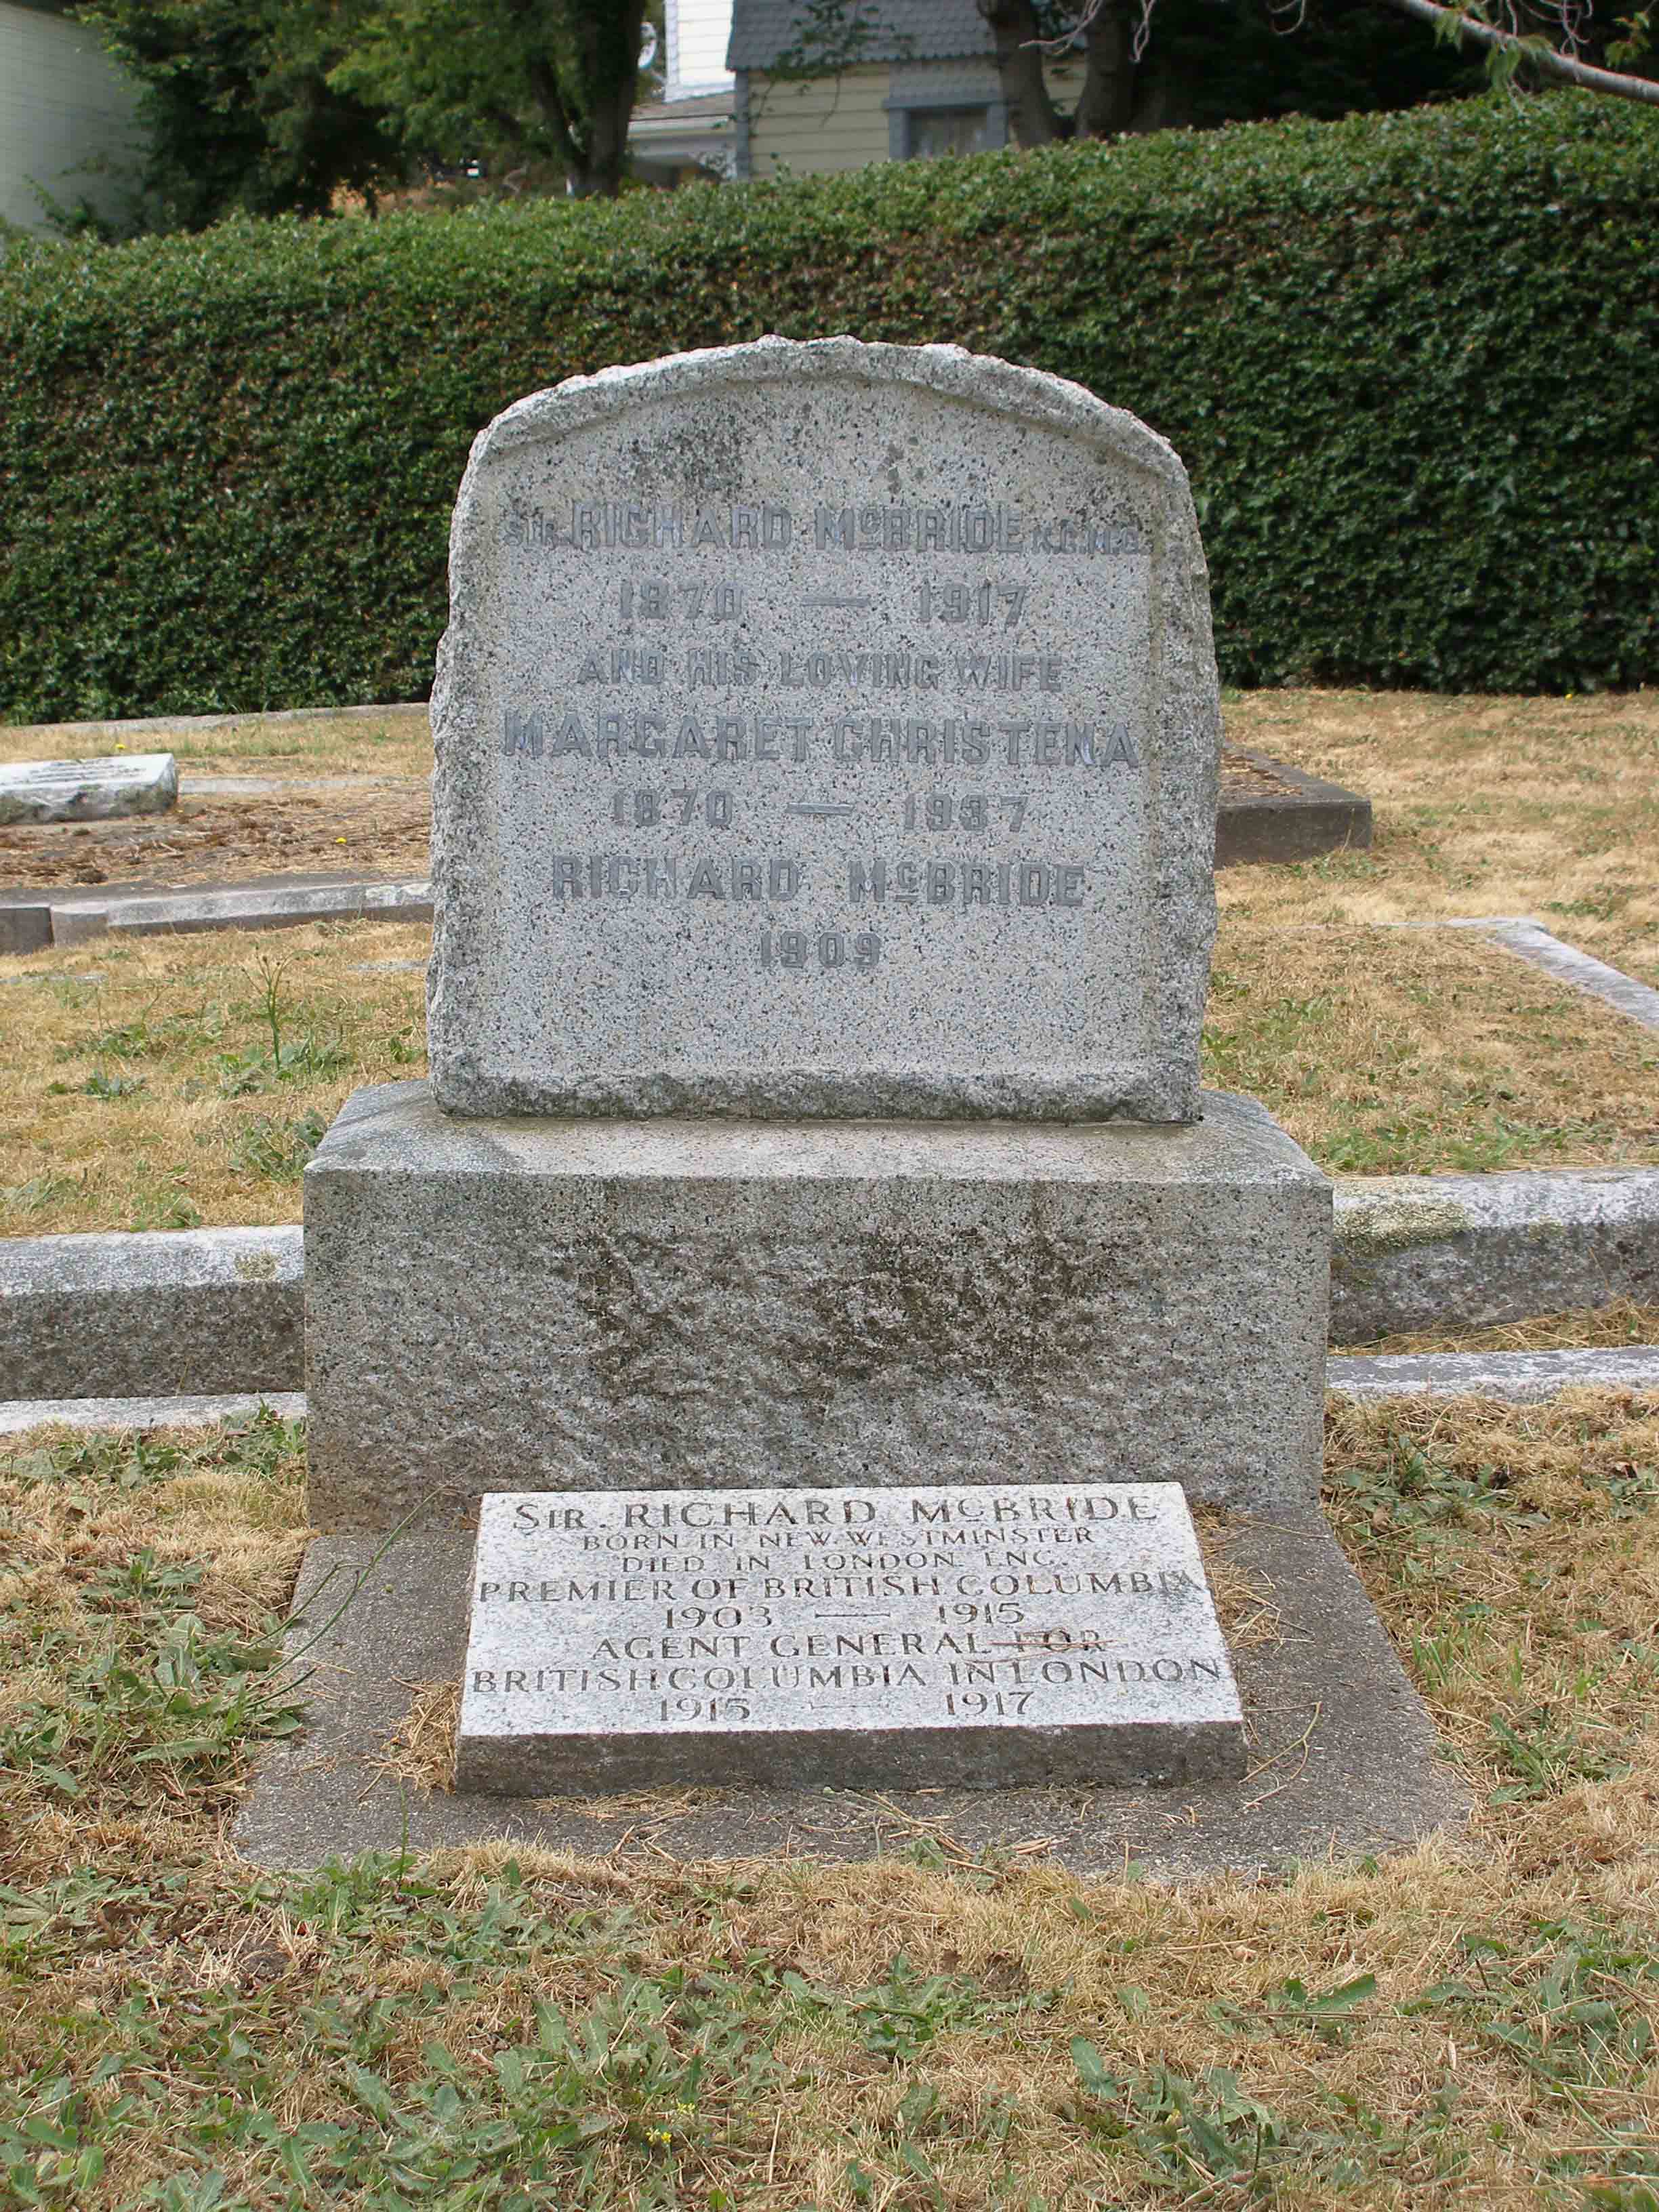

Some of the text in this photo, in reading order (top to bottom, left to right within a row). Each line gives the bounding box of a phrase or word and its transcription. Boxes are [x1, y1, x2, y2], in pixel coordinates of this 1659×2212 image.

[573, 499, 792, 548] RICHARD
[619, 579, 1028, 626] 1870 1917
[580, 650, 1063, 692] AND HIS LOVING WIFE
[504, 711, 1139, 768] MARGARET CHRISTENA
[612, 788, 1029, 832] 1870 1937
[553, 855, 799, 901] RICHARD
[761, 930, 881, 968] 1909
[624, 1499, 876, 1528] RICHARD
[583, 1527, 1095, 1551] BORN IN NEW WESTMINSTER
[623, 1556, 705, 1573] DIED
[736, 1555, 771, 1571] IN
[479, 1570, 1203, 1602] PREMIER OF BRITISH COLUMBIA
[666, 1601, 1025, 1629] 1903 1915
[592, 1626, 1105, 1660] AGENT GENERAL FOR
[473, 1657, 1219, 1693] BRITISH COLUMBIA IN LONDON
[659, 1691, 1035, 1721] 1915 1917
